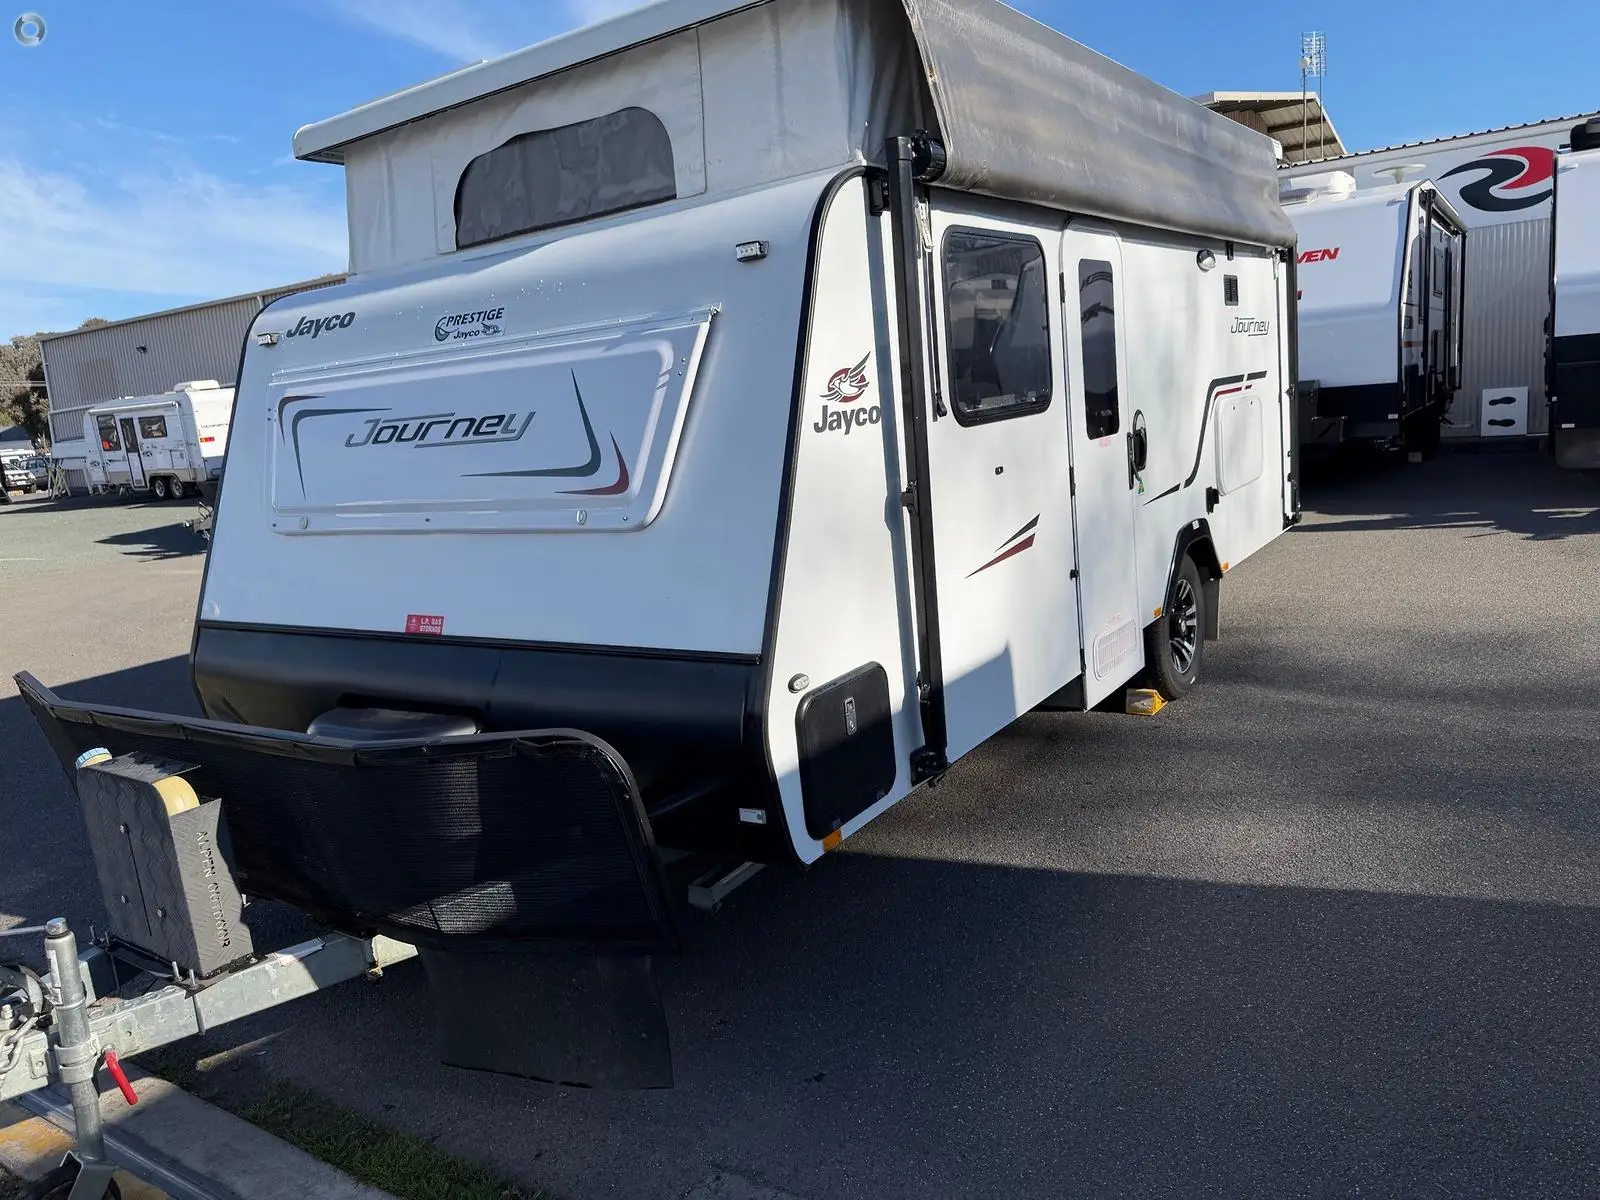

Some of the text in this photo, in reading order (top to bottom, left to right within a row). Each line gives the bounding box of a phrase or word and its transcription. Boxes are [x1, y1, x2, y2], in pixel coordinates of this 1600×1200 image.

[286, 311, 356, 339] Jayco
[446, 307, 505, 327] PRESTIGE
[1230, 316, 1270, 337] Journey
[453, 329, 480, 340] Jayco
[345, 411, 536, 449] Journey
[813, 404, 881, 435] Jayco
[207, 882, 231, 948] OUTDOOR
